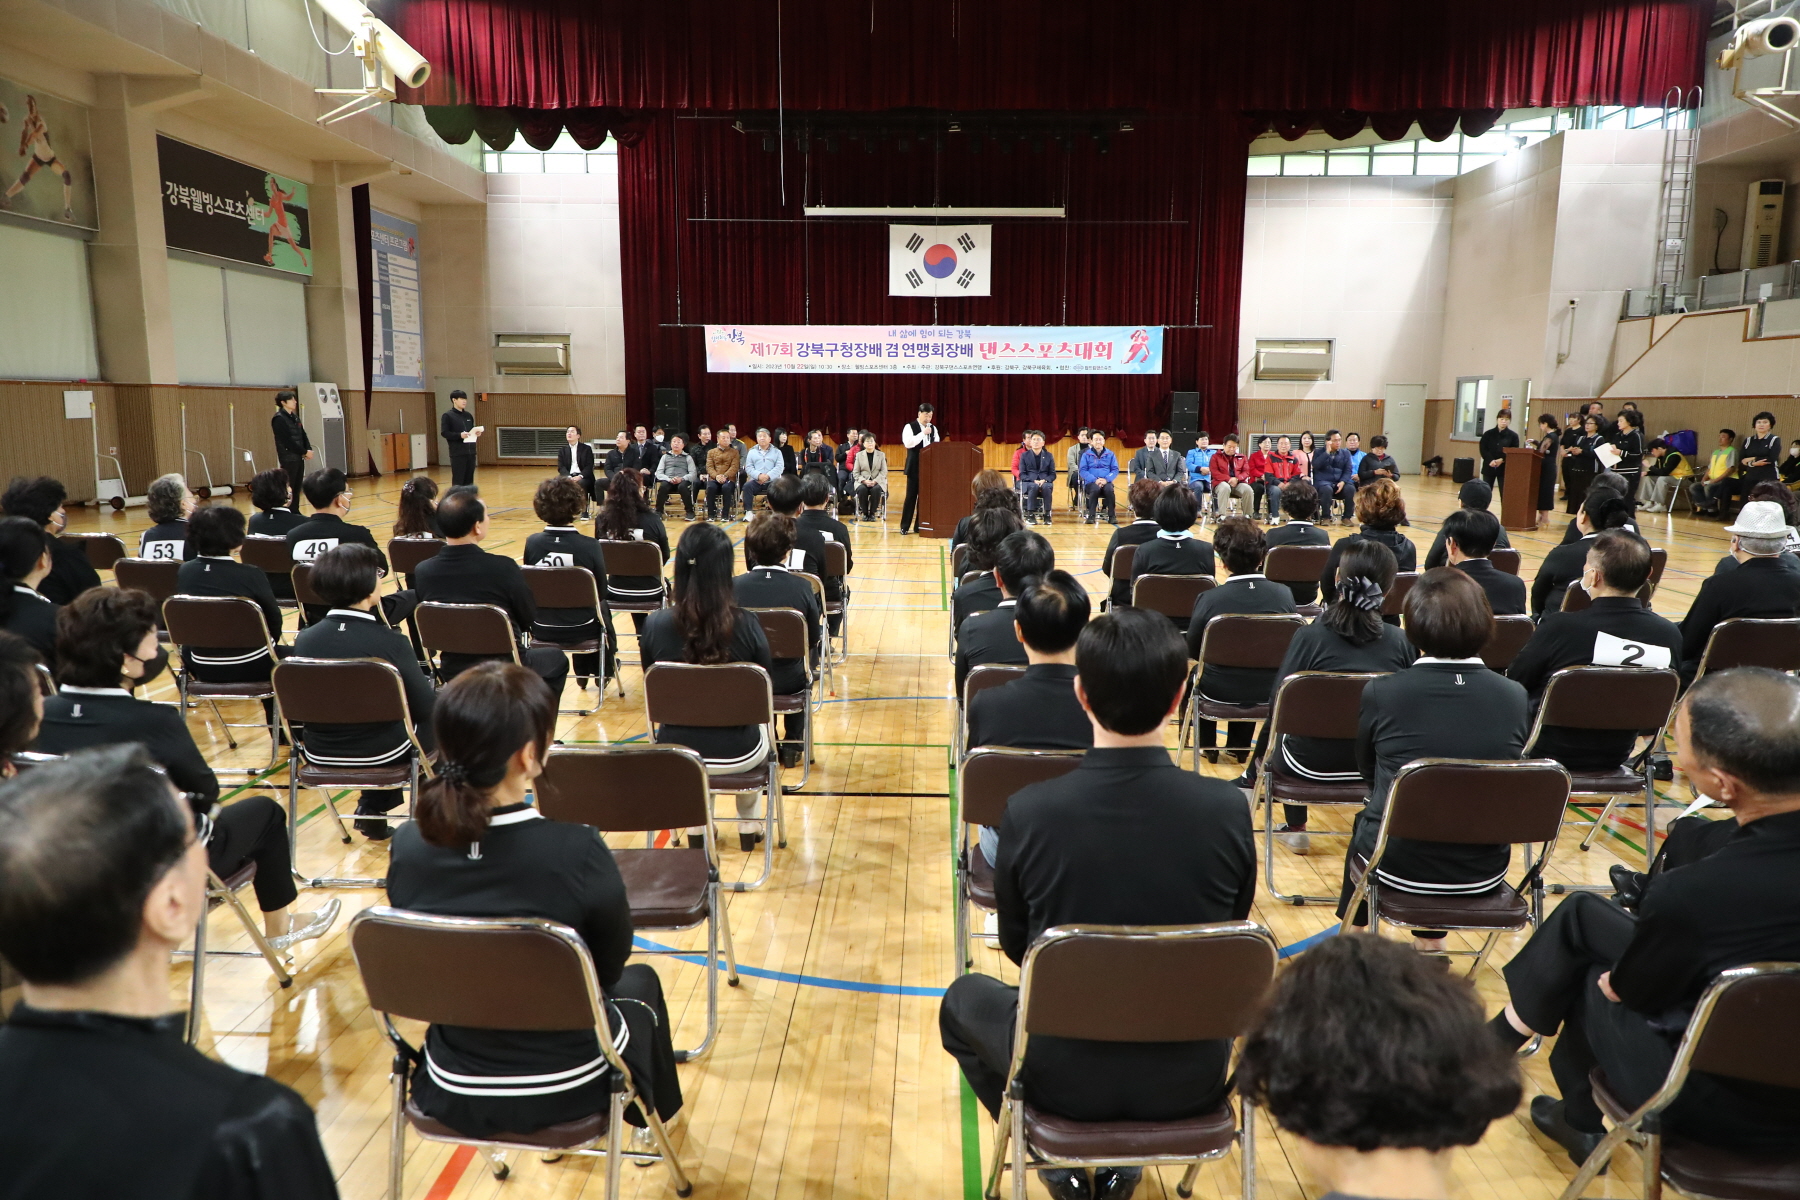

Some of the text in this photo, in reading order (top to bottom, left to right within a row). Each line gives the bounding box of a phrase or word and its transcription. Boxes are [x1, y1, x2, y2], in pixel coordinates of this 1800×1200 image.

[165, 180, 265, 226] 강북웰빙스포츠센터
[888, 330, 972, 339] 내 삶에 힘이 되는 강북
[750, 341, 1113, 361] 제17회 강북구청장배 겸 연맹회장배 댄스스포츠대회
[152, 543, 175, 560] 53
[304, 541, 329, 559] 49
[541, 553, 565, 567] 50
[1620, 644, 1646, 667] 2
